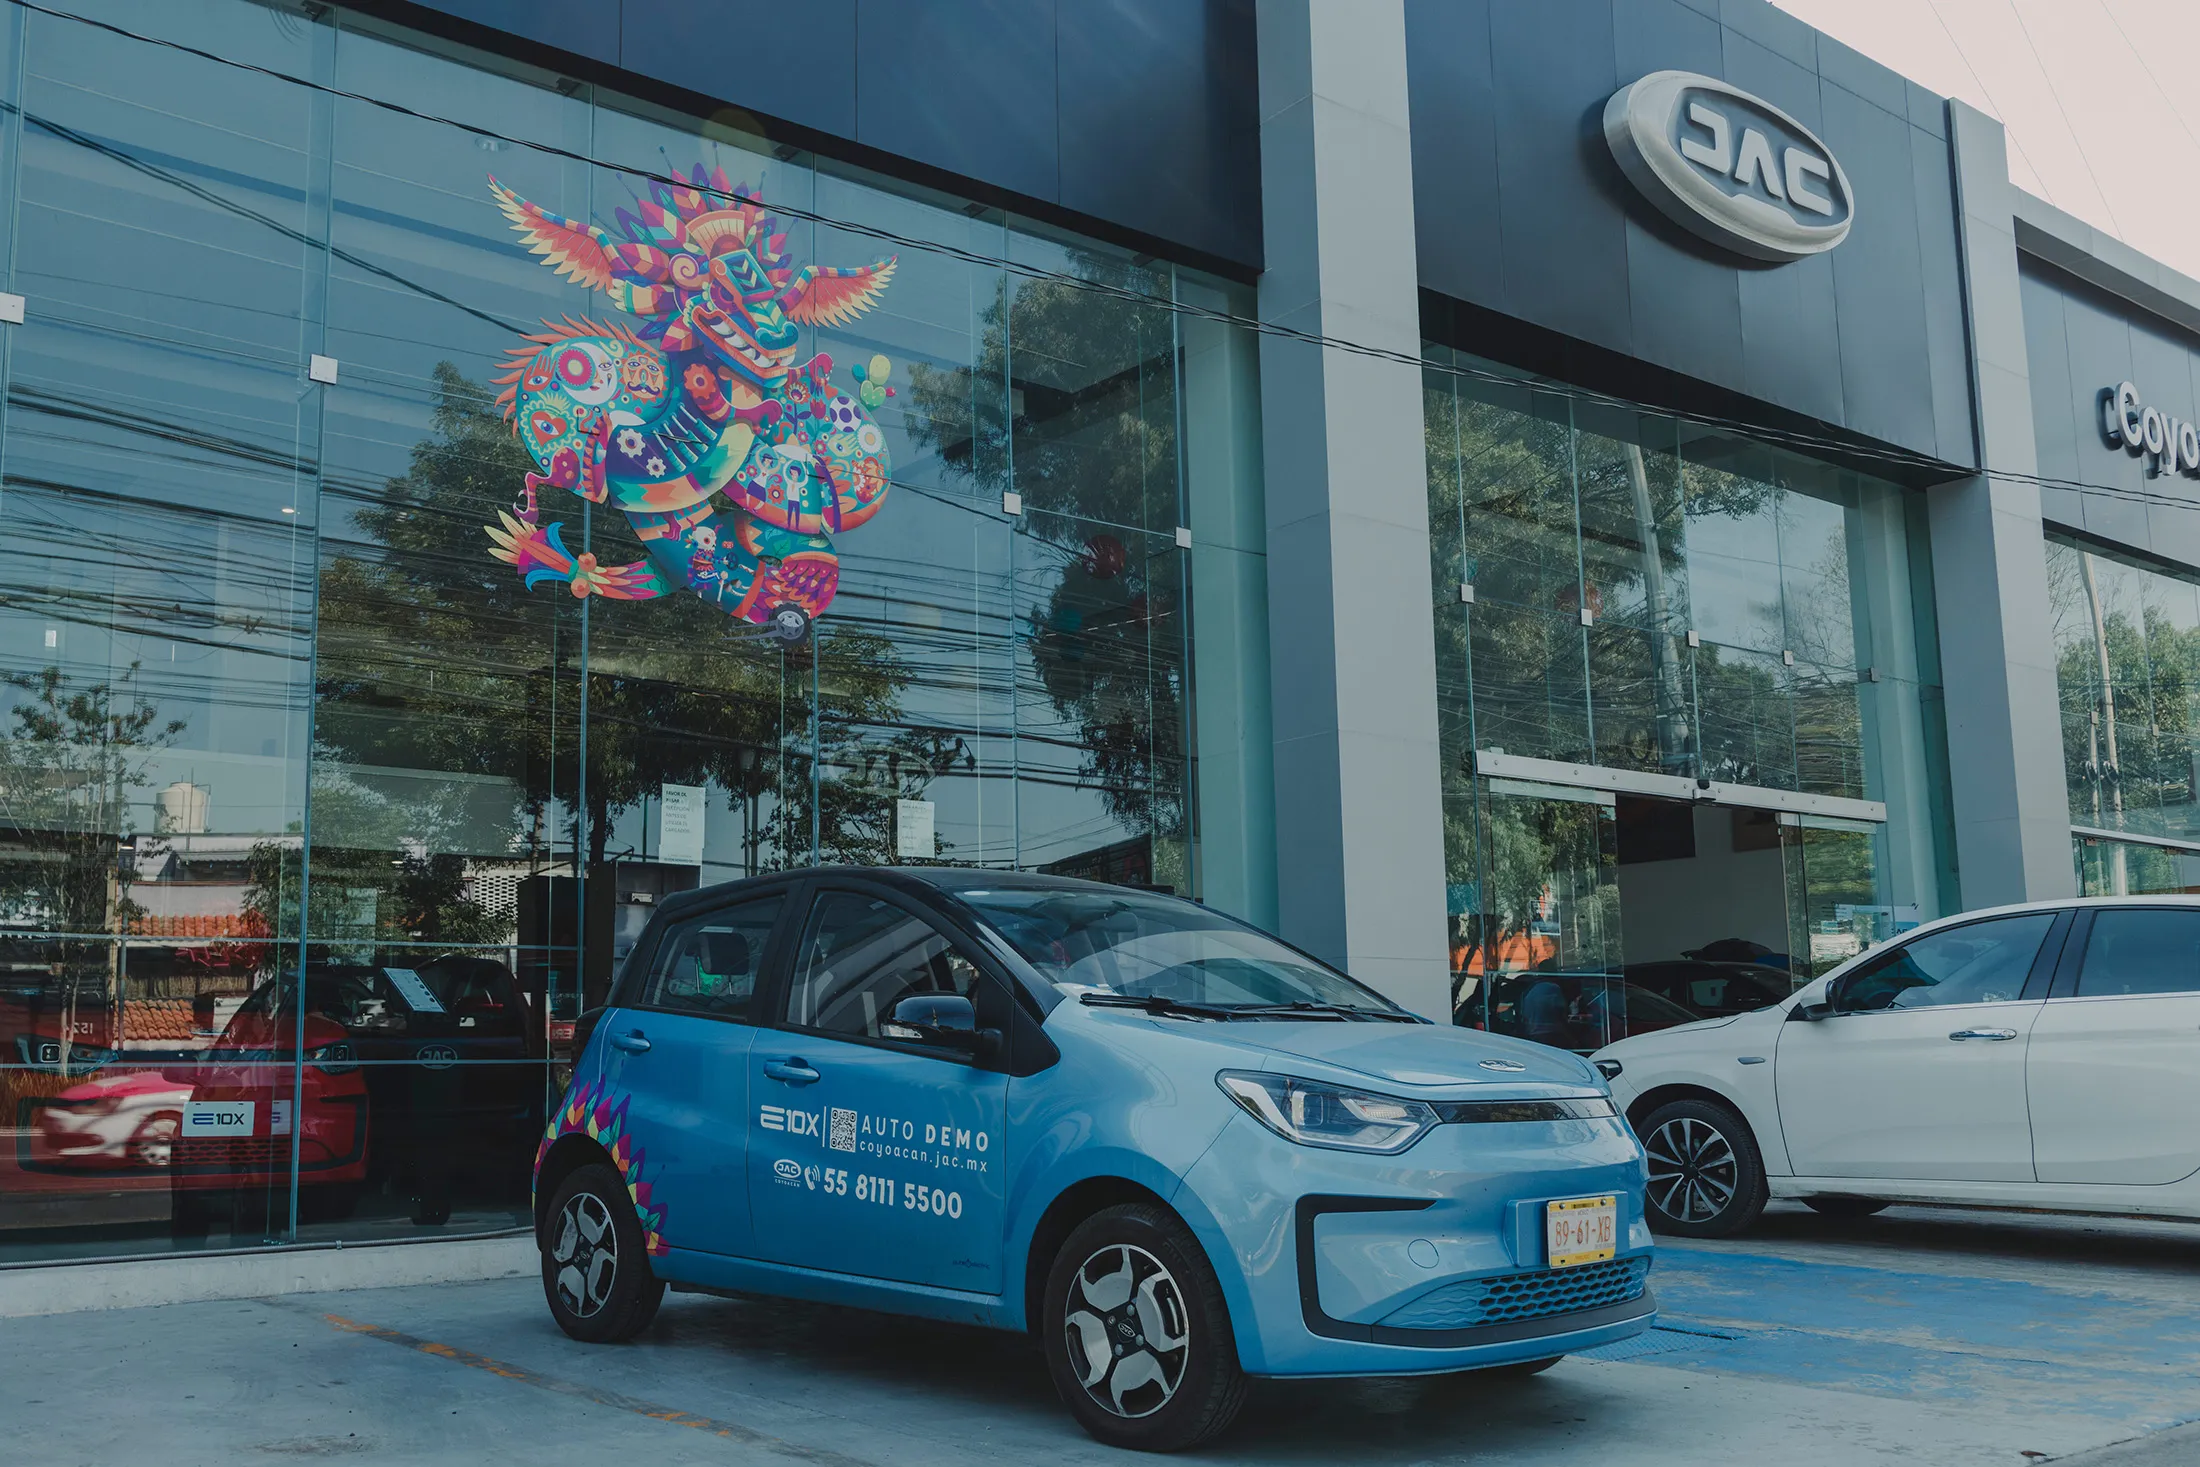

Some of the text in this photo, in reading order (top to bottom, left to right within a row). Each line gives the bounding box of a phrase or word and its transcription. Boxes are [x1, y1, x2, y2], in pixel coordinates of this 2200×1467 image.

[1680, 102, 1833, 217] JAC
[2113, 380, 2200, 476] Coyo
[192, 1112, 245, 1126] E10X
[760, 1104, 820, 1137] E10X
[861, 1115, 989, 1152] AUTO DEMO
[777, 1163, 797, 1174] JAC
[859, 1140, 988, 1173] coyoacan.jac.mx
[823, 1167, 963, 1219] 55 8111 5500
[1555, 1216, 1612, 1247] 89-61-XB
